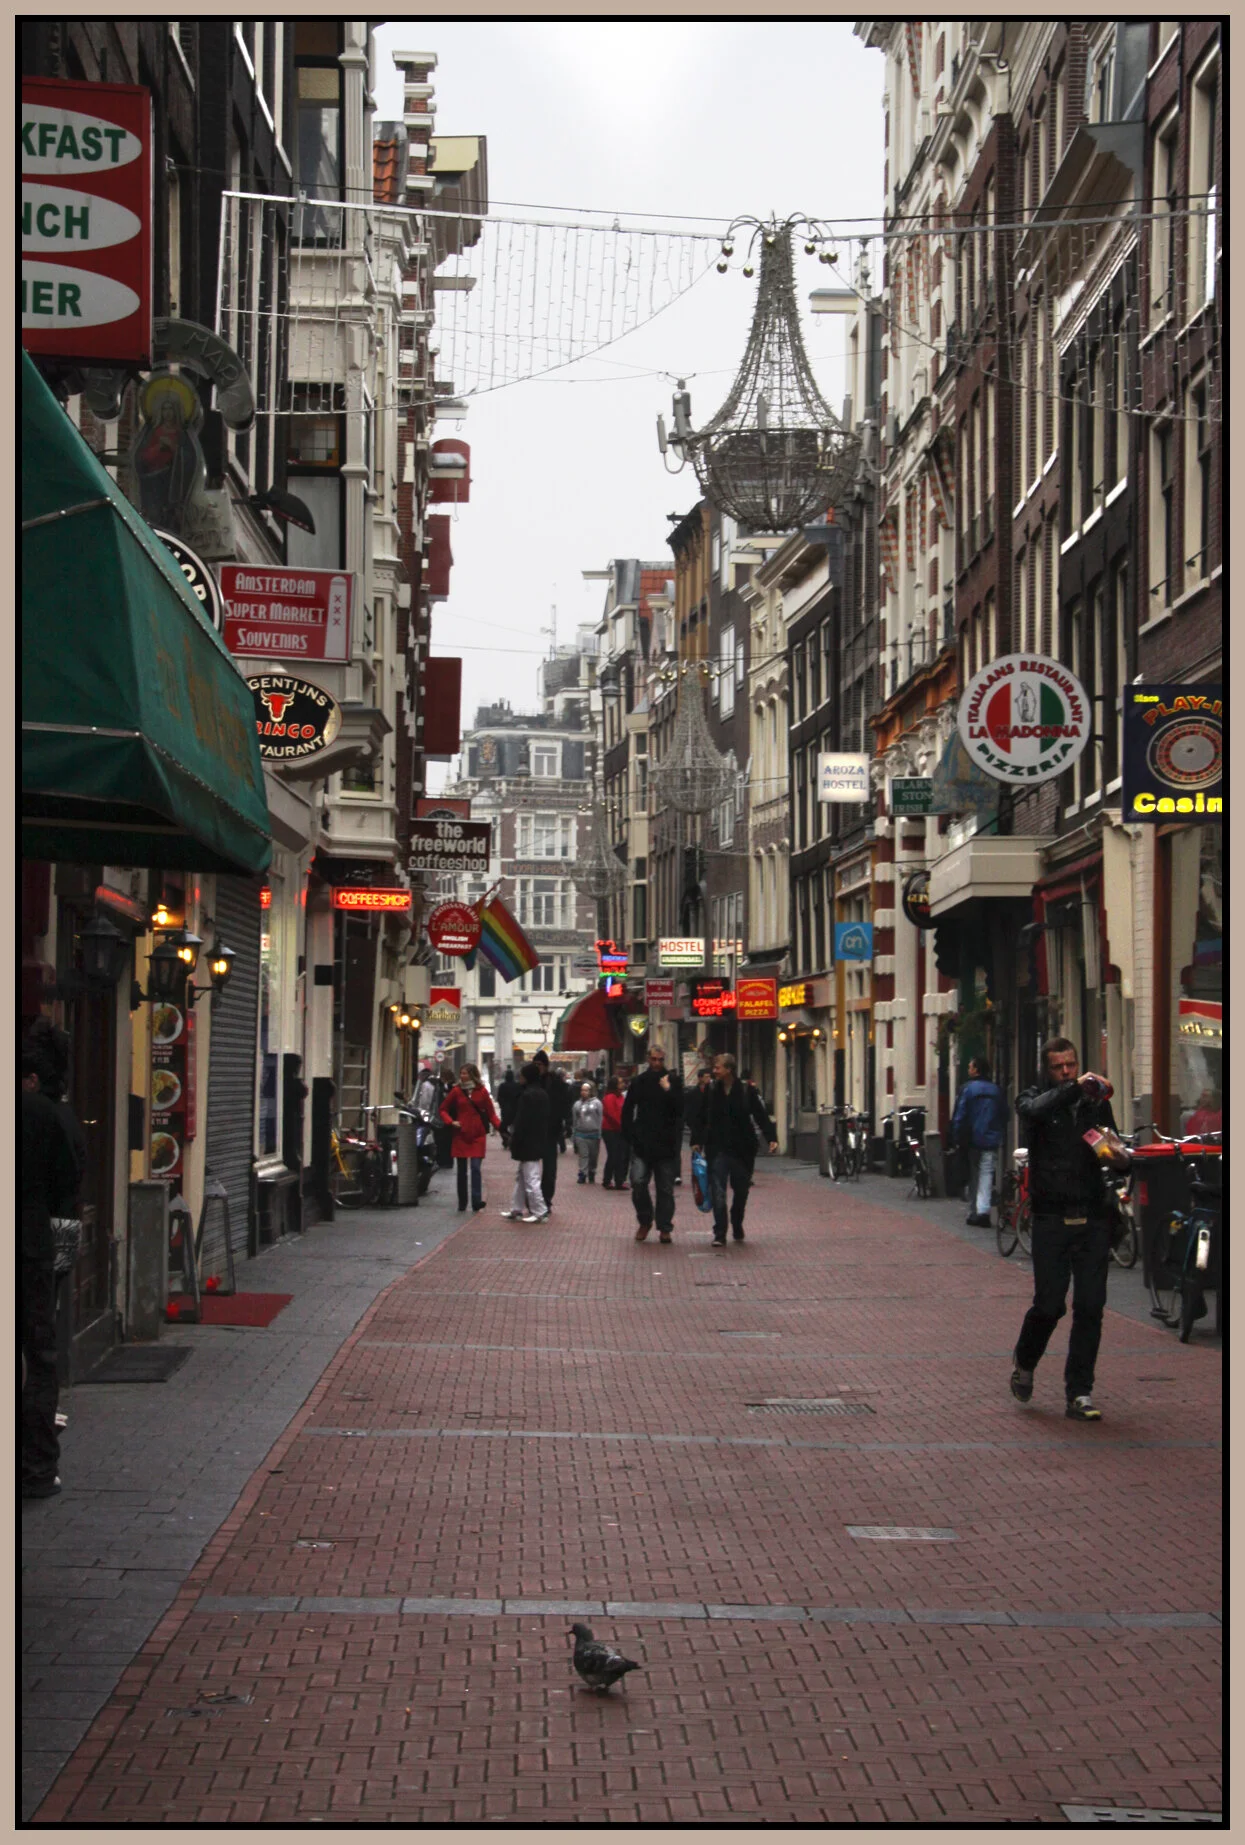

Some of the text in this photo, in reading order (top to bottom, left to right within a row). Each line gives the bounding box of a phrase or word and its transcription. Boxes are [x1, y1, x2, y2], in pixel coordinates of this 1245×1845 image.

[235, 572, 316, 595] AMSTERDAM
[224, 599, 325, 624] SUPER MARKET
[237, 628, 308, 650] SOUVENIRS
[967, 660, 1084, 724] ITALIAANS RESTAURANT
[1142, 695, 1222, 726] PLAY-I
[969, 725, 1081, 739] LA MADONNA
[976, 742, 1075, 777] PIZZERIA
[823, 765, 866, 776] AROZA
[823, 779, 867, 791] HOSTEL
[435, 822, 464, 838] the
[410, 834, 487, 854] freeworld
[408, 854, 488, 872] coffeeshop
[338, 892, 411, 906] COFFEESHOP
[660, 941, 704, 952] HOSTEL
